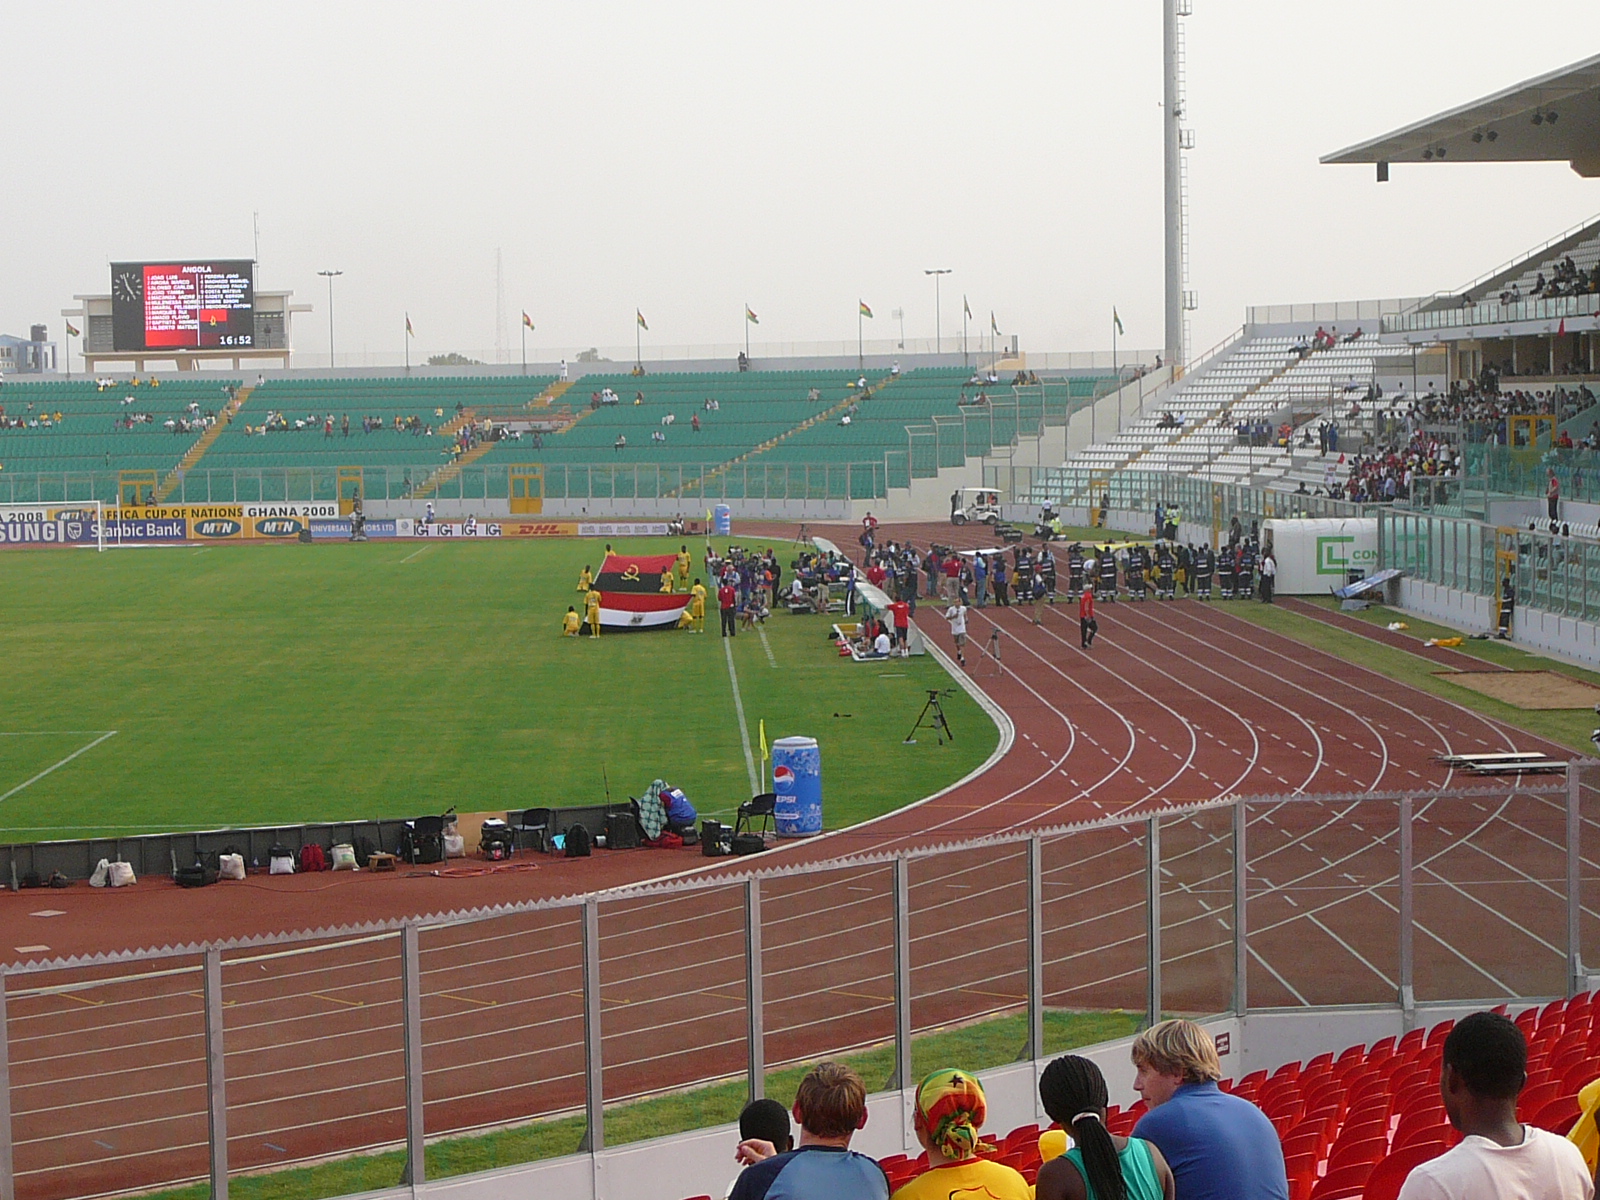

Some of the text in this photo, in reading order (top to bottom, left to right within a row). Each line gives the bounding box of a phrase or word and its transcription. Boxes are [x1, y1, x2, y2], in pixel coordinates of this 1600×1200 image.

[182, 265, 212, 273] ANGOLA
[220, 336, 252, 344] 16:52
[144, 510, 167, 519] CUP
[172, 508, 187, 518] OF
[191, 507, 244, 518] NATIONS
[248, 506, 336, 517] GHANA 2008
[8, 512, 44, 522] 2008
[146, 522, 182, 537] Bank
[202, 522, 232, 534] MTN
[264, 522, 294, 532] MTN
[519, 524, 560, 534] DHL
